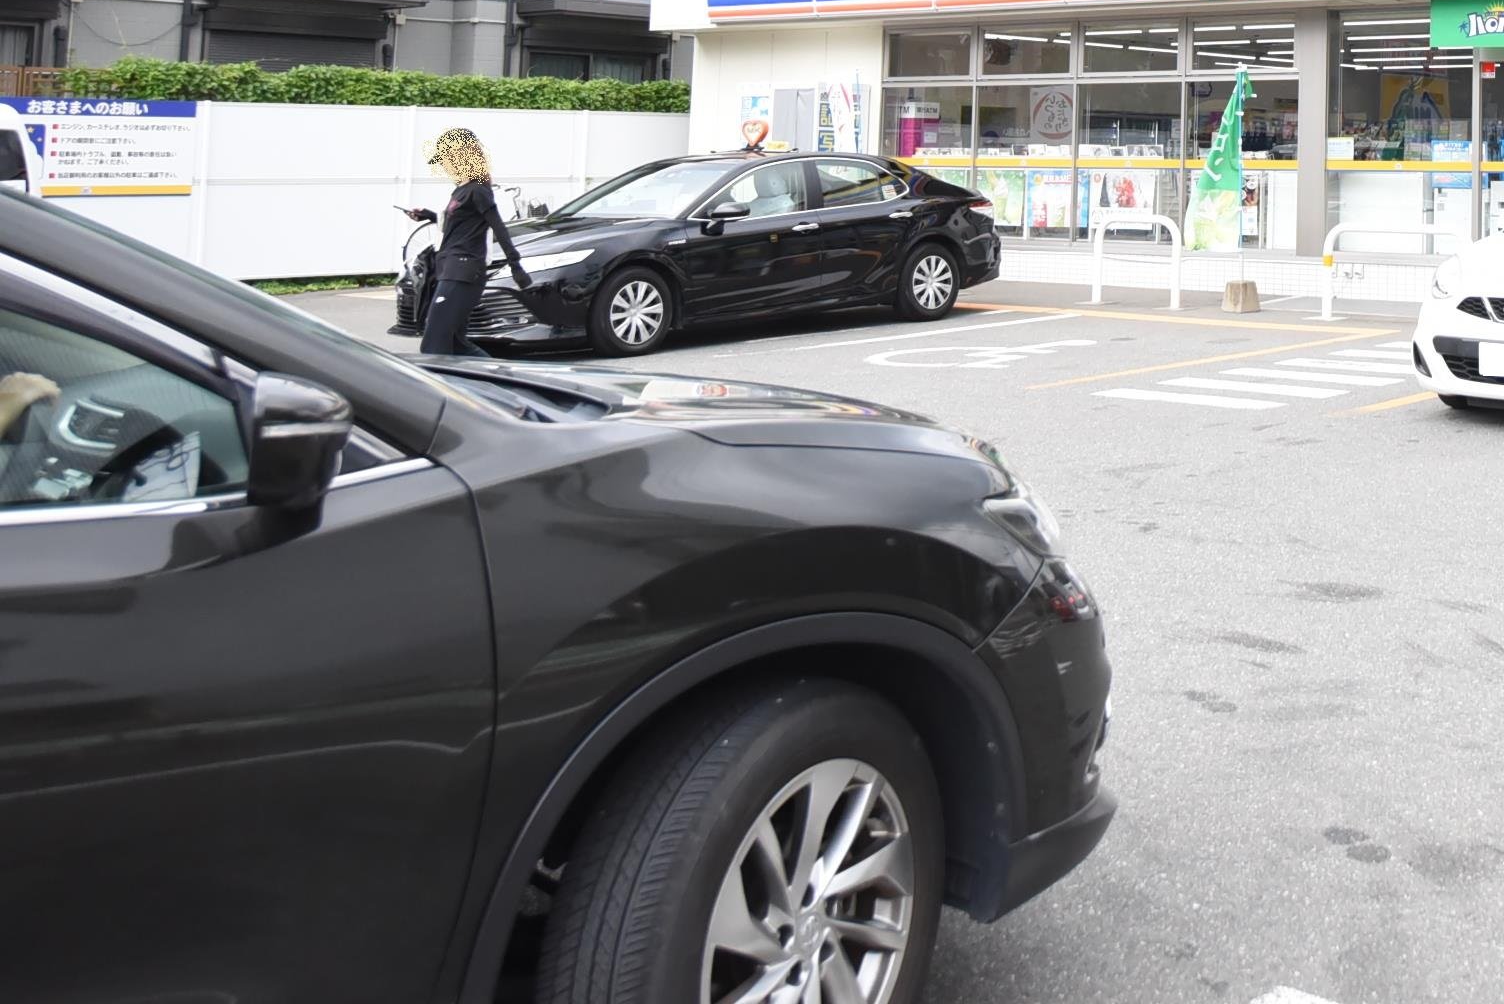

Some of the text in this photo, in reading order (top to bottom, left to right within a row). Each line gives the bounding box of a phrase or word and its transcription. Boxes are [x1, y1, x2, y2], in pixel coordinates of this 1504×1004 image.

[28, 100, 149, 115] お客さまへのお願い
